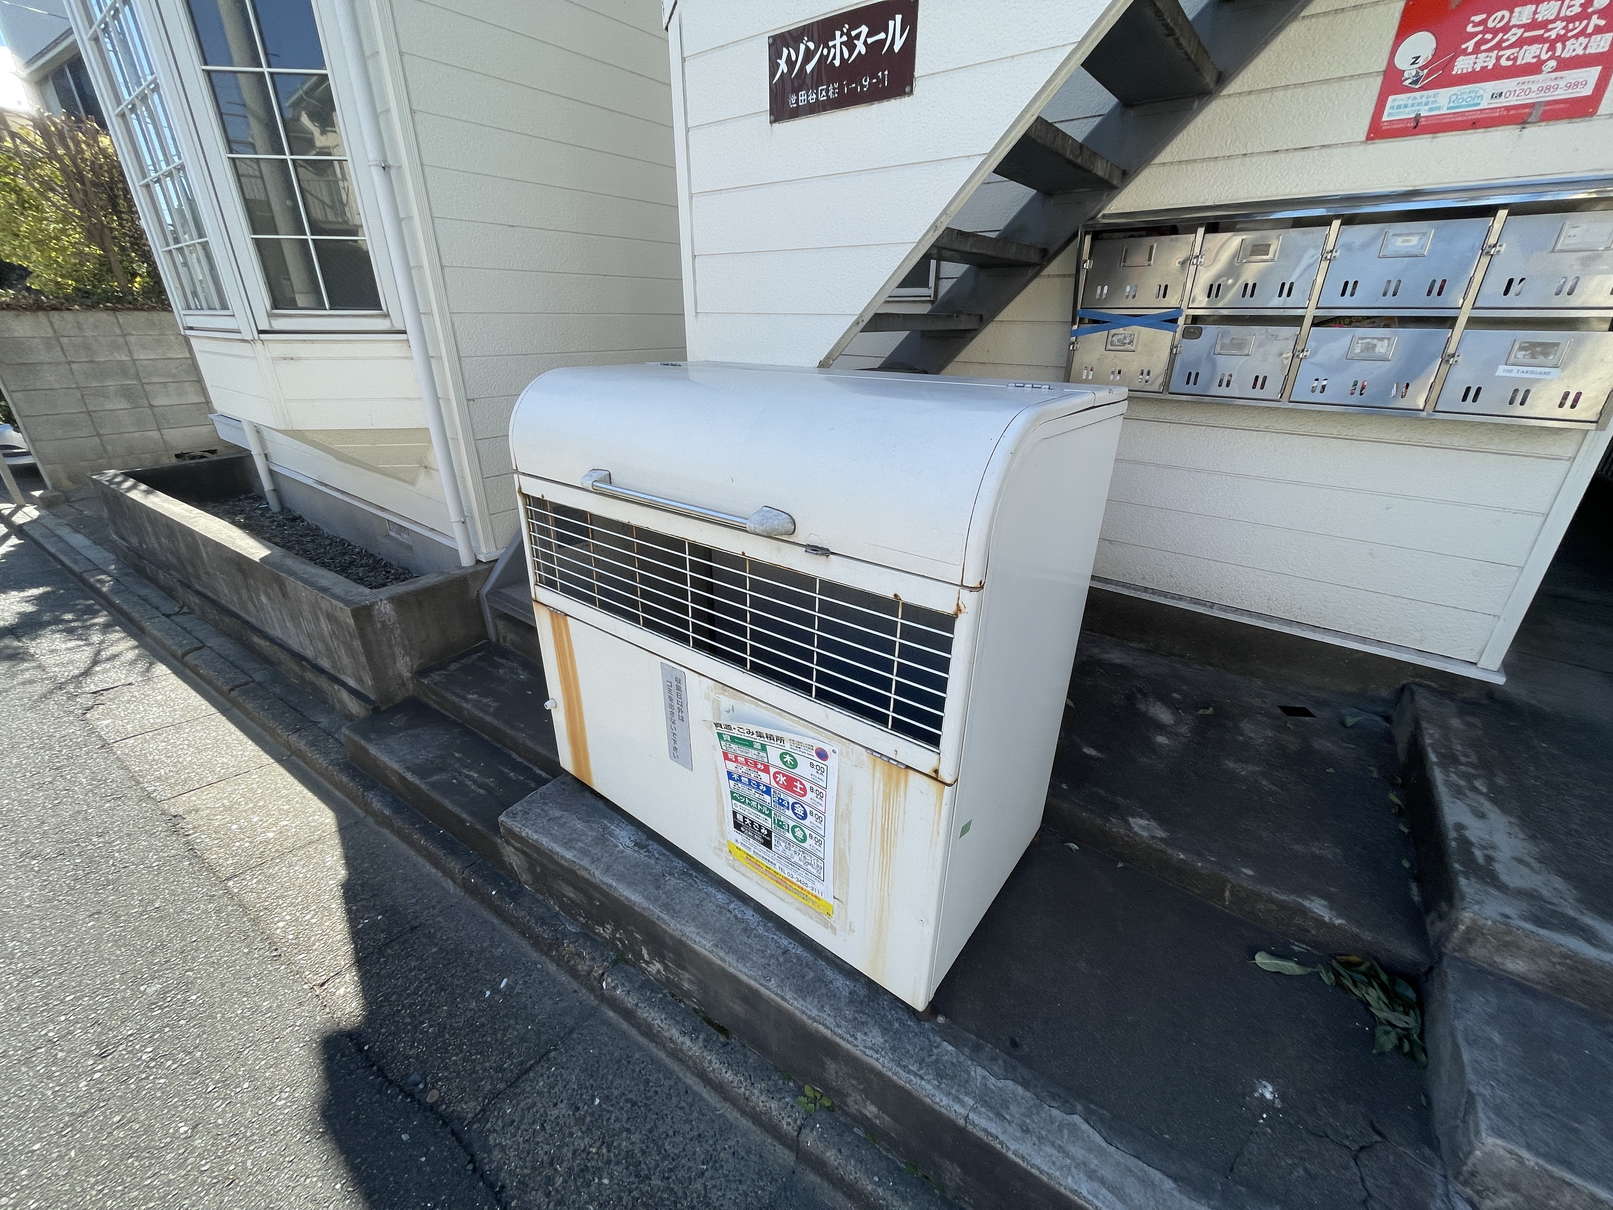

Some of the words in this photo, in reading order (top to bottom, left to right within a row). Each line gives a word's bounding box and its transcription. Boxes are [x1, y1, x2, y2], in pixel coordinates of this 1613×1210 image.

[1461, 14, 1607, 53] インターネット
[772, 14, 910, 84] メゾン・ボヌール
[1452, 33, 1613, 74] 無料で使い放題
[1503, 80, 1588, 101] 0120-989-989
[782, 755, 794, 765] 木
[809, 761, 825, 774] 8:00
[775, 773, 787, 785] 水
[793, 781, 805, 794] 土
[809, 786, 824, 799] 8:00
[733, 793, 770, 814] ペットボトル
